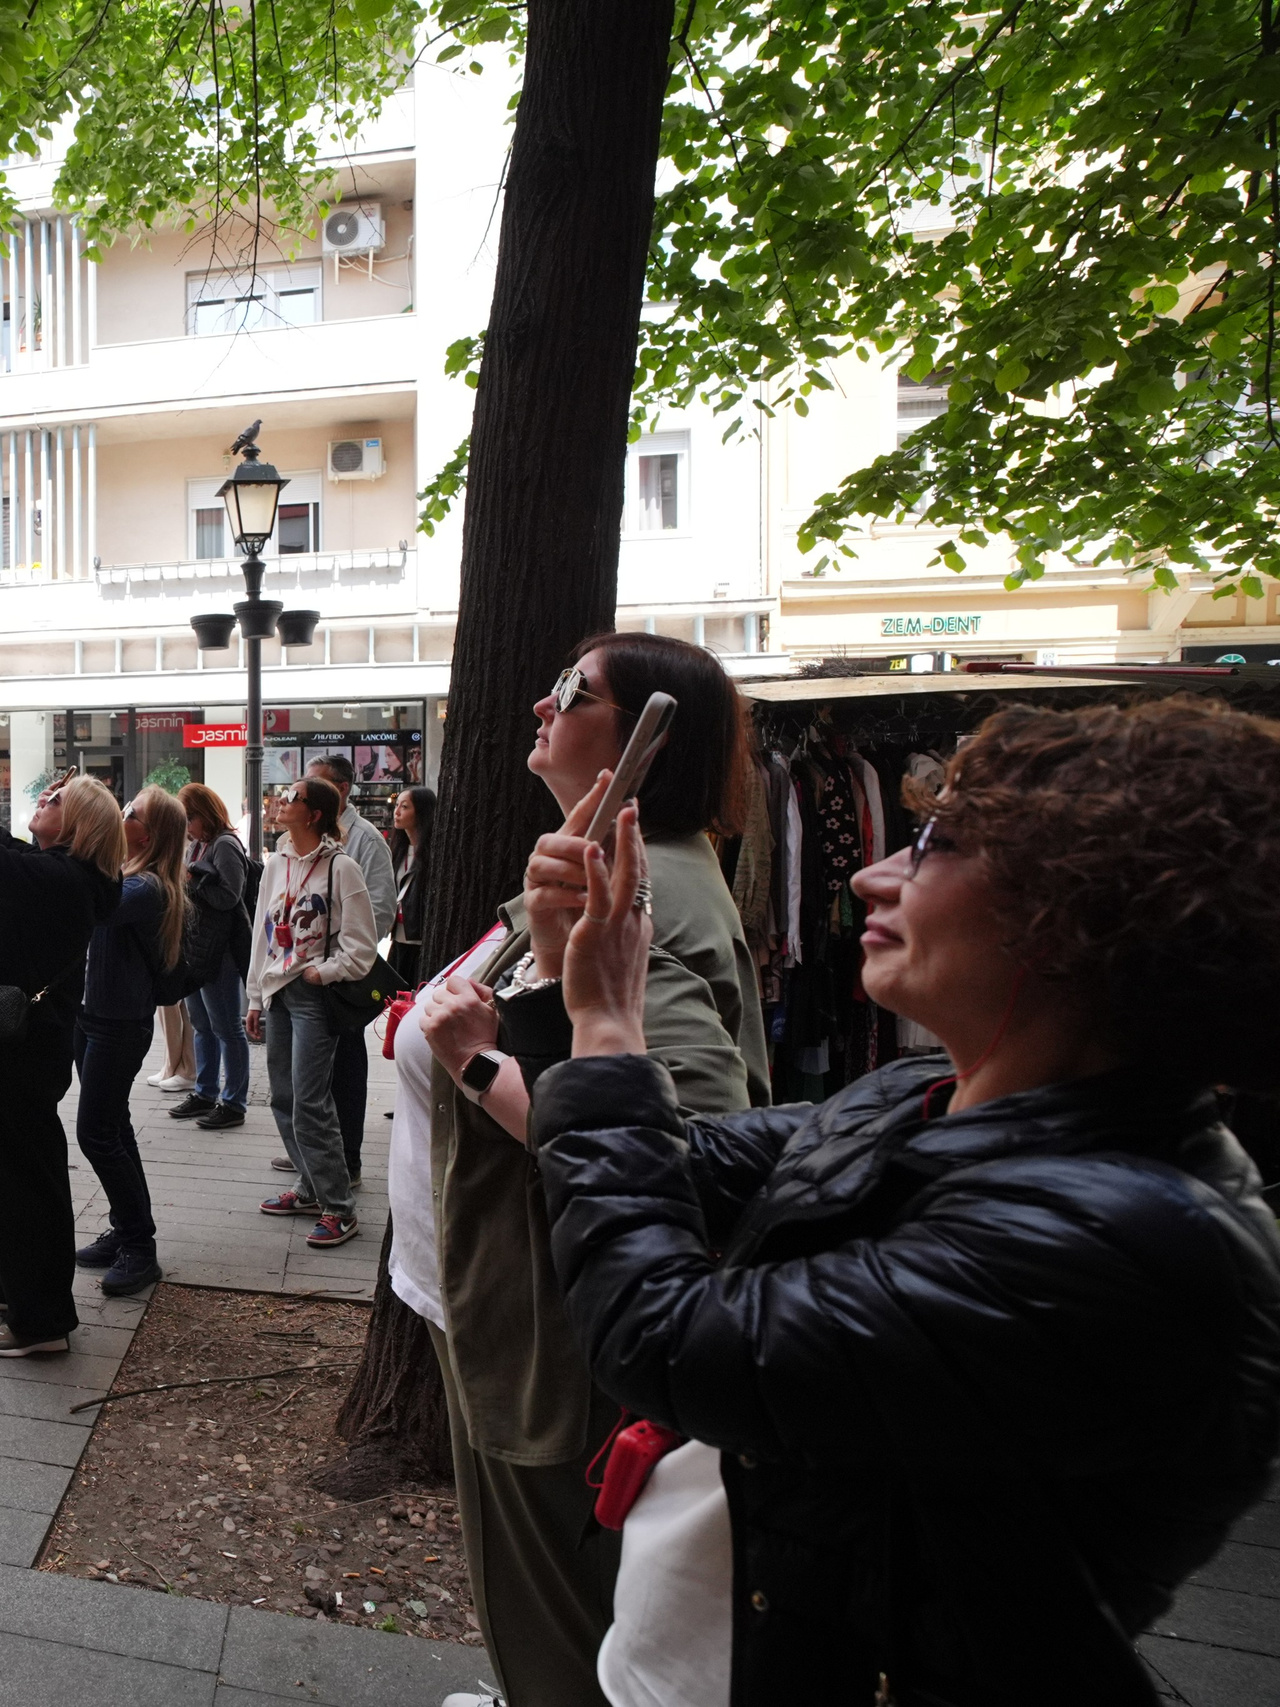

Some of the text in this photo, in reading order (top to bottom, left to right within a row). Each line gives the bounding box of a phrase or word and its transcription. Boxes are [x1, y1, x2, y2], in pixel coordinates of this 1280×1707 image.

[882, 615, 982, 635] ZEM-DENT
[311, 732, 345, 741] SHISEIDO
[360, 732, 398, 741] LANCÔME
